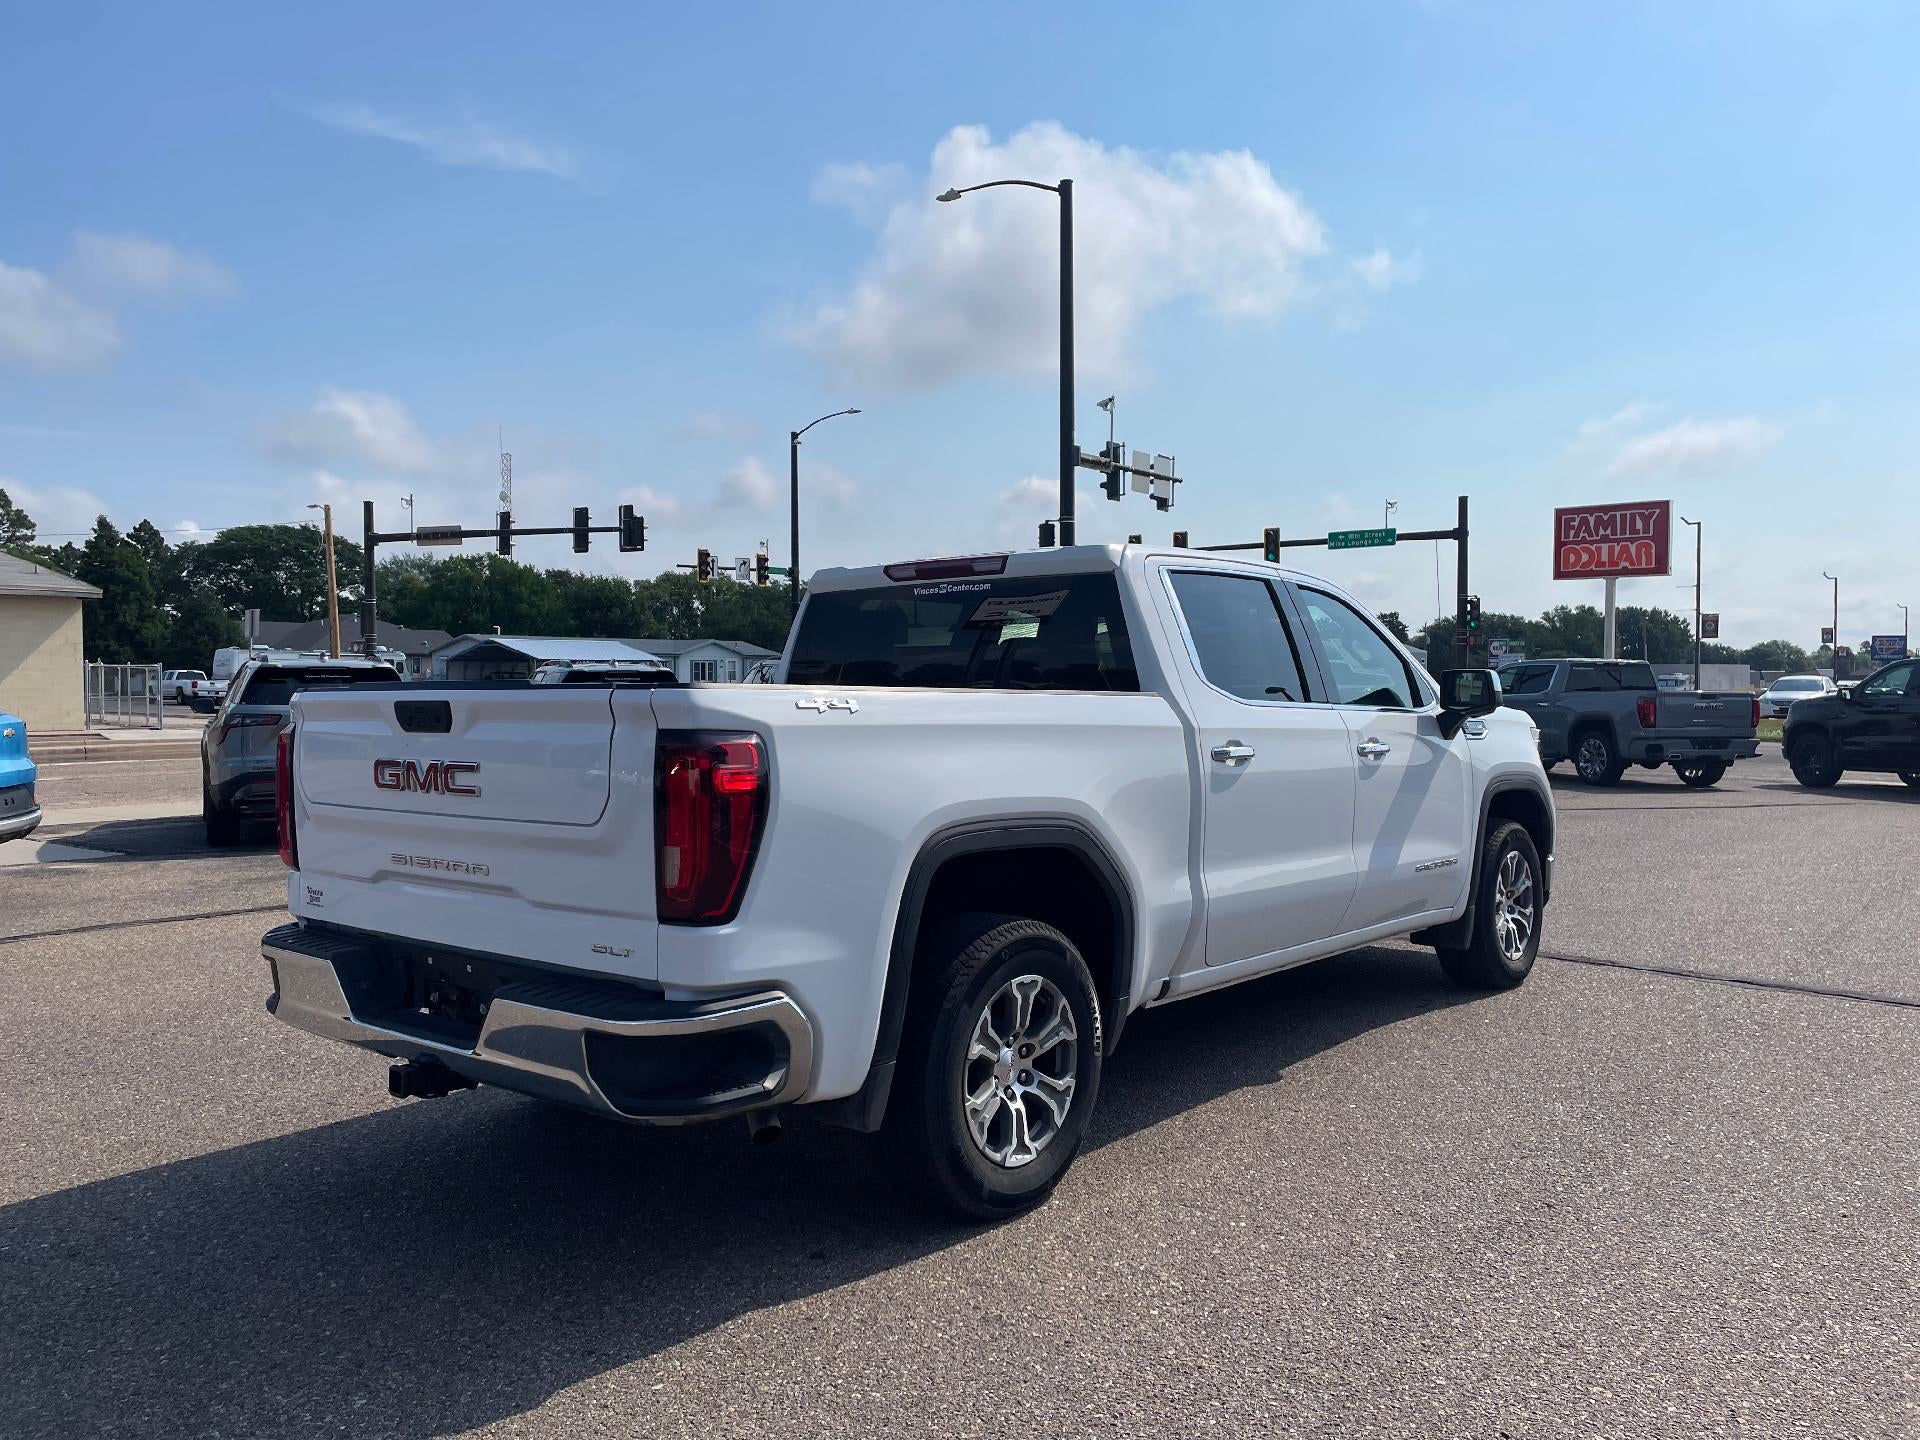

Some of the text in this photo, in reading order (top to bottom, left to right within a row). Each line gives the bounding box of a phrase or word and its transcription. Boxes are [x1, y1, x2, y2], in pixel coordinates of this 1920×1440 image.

[1562, 509, 1660, 541] FAMILY
[1561, 540, 1656, 571] DOLLAR
[374, 759, 481, 797] GMC
[390, 853, 489, 876] SIERRA
[591, 944, 635, 958] SLT
